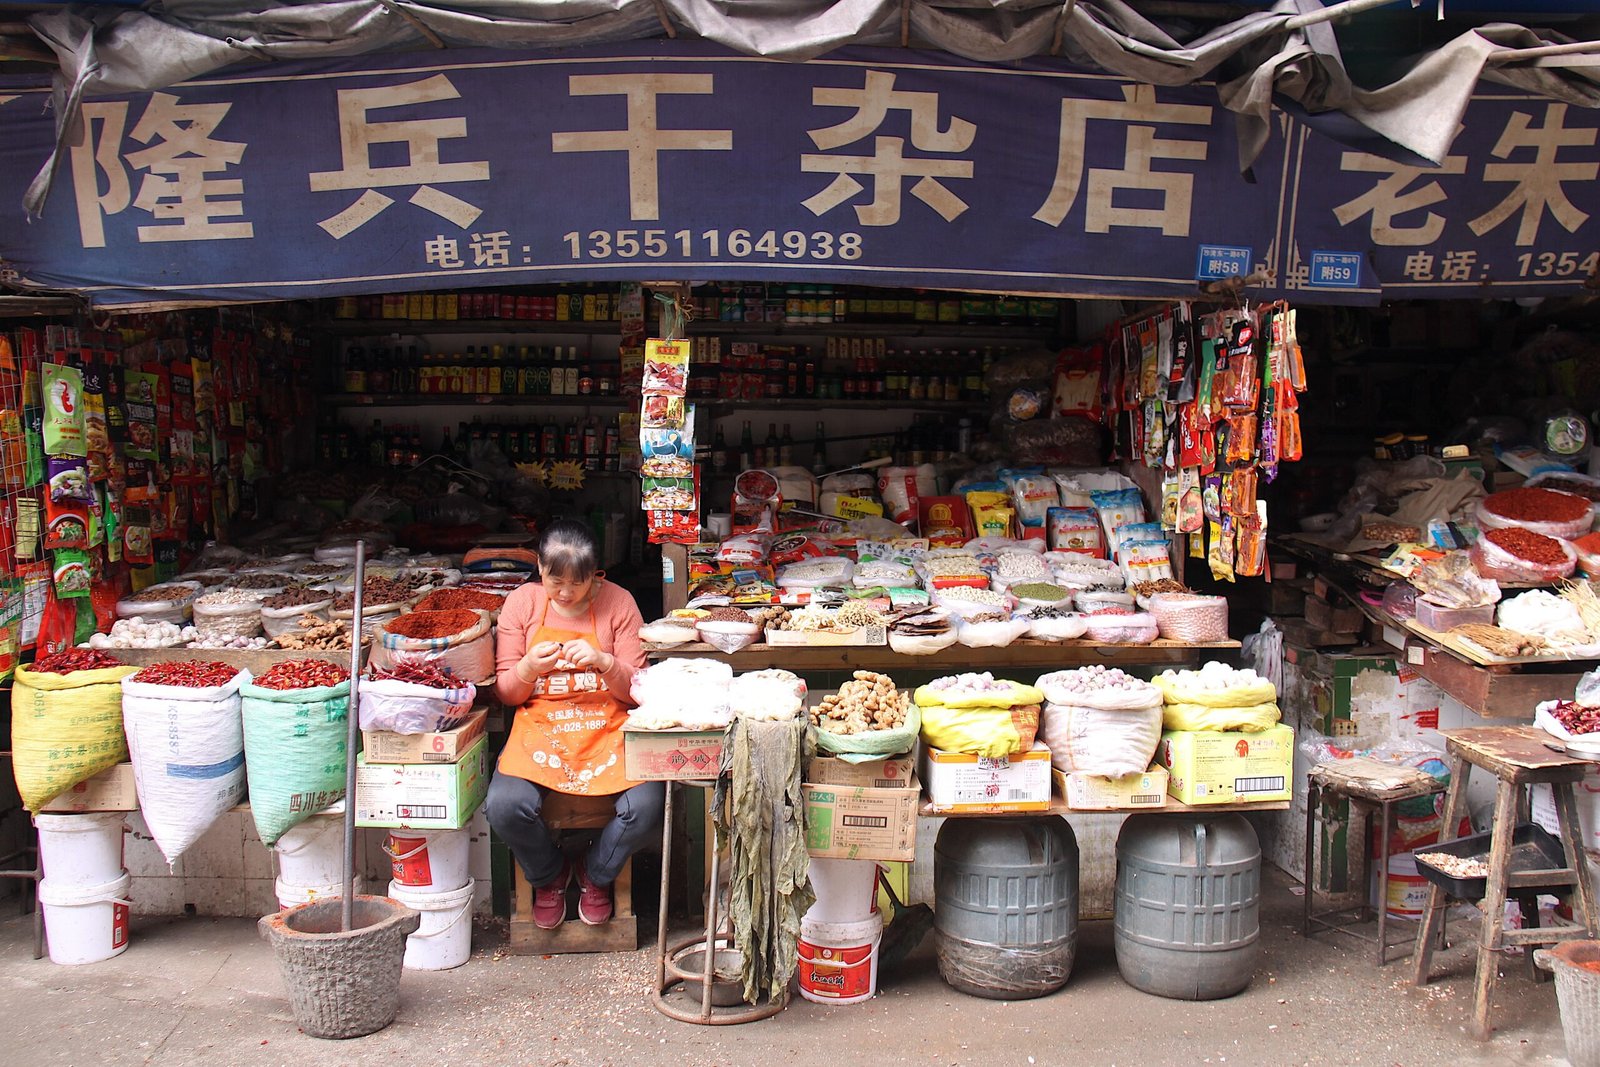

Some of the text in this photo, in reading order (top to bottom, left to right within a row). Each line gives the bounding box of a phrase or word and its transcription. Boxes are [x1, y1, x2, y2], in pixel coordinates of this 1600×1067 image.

[69, 69, 1213, 249] 隆兵干杂店
[1332, 102, 1600, 247] 老朱
[562, 229, 864, 261] 13551164938
[1208, 260, 1240, 274] 附58
[1320, 266, 1351, 280] 附59
[432, 735, 445, 753] 6
[883, 761, 898, 779] 6
[809, 791, 834, 803] 好人家
